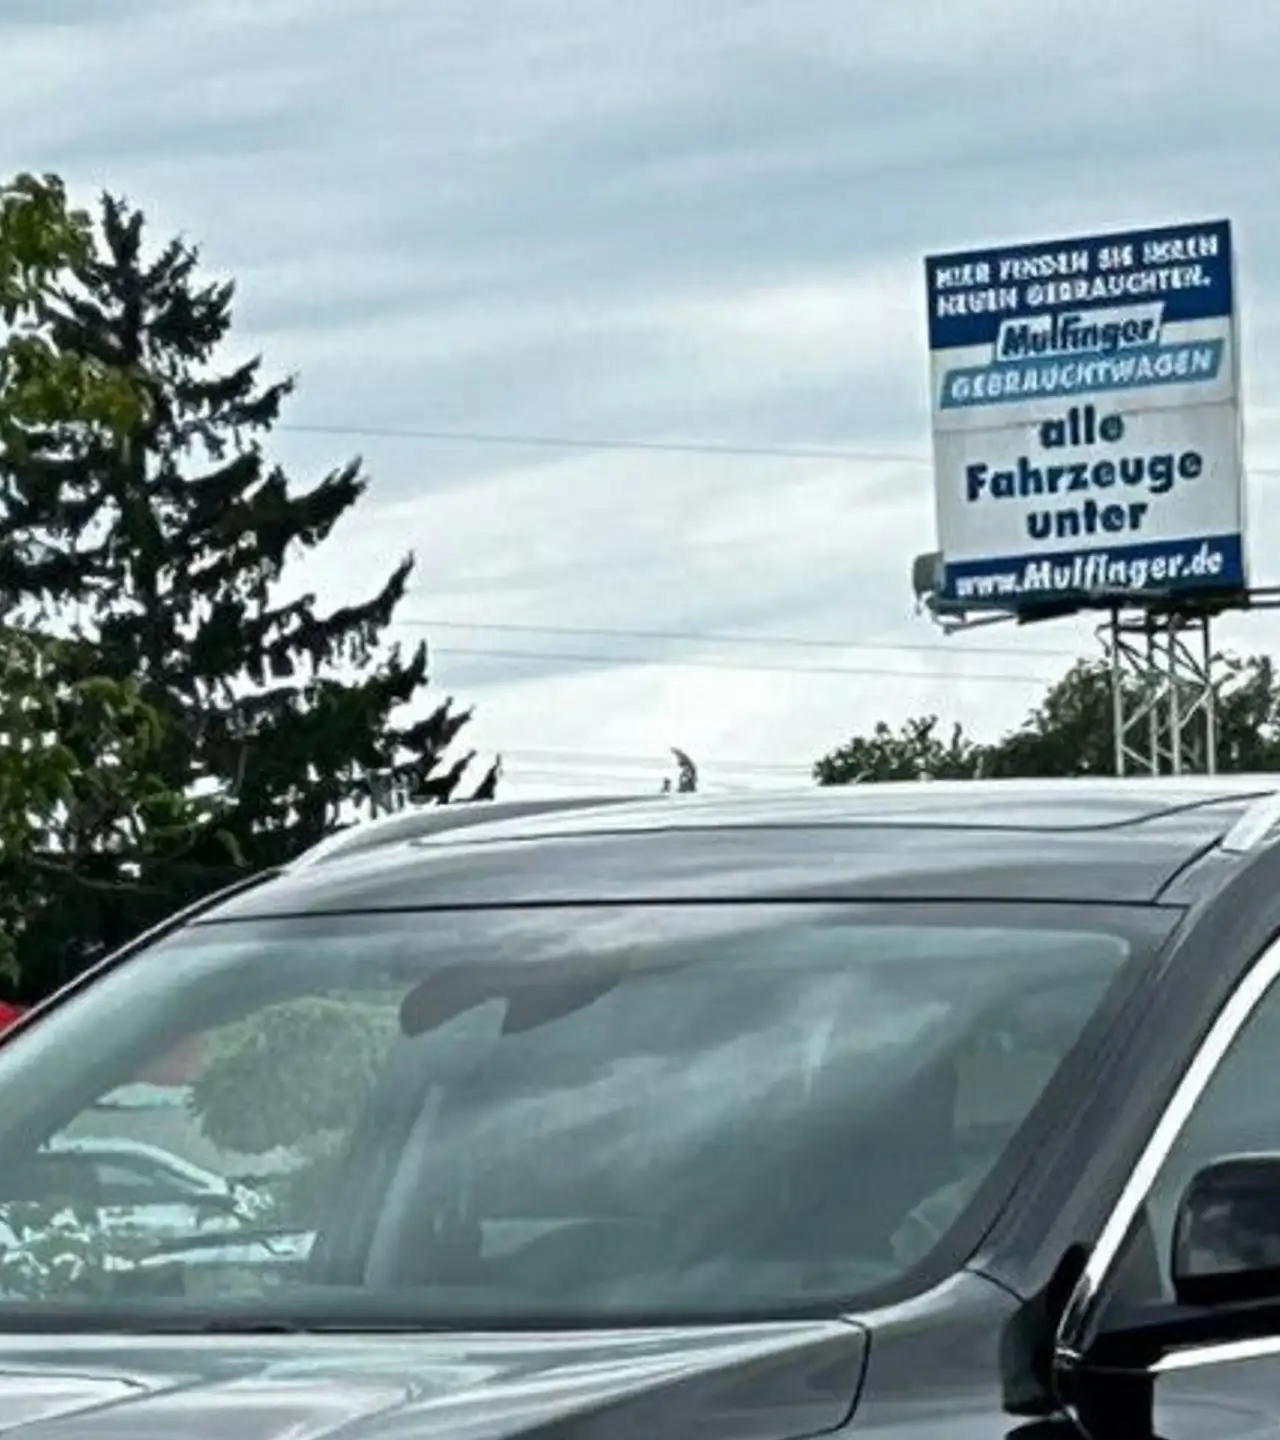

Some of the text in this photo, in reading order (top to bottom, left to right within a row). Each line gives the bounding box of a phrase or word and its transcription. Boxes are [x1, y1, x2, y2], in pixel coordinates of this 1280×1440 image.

[1024, 264, 1212, 307] GEBRAUCHTEN.
[1001, 313, 1155, 359] Mulfinger
[950, 349, 1214, 400] GEBRAUCHTWAGEN
[1038, 404, 1125, 449] alle
[965, 450, 1203, 502] Fahrzeuge
[1026, 499, 1148, 539] unter
[955, 543, 1224, 597] www.Mulfinger.de
